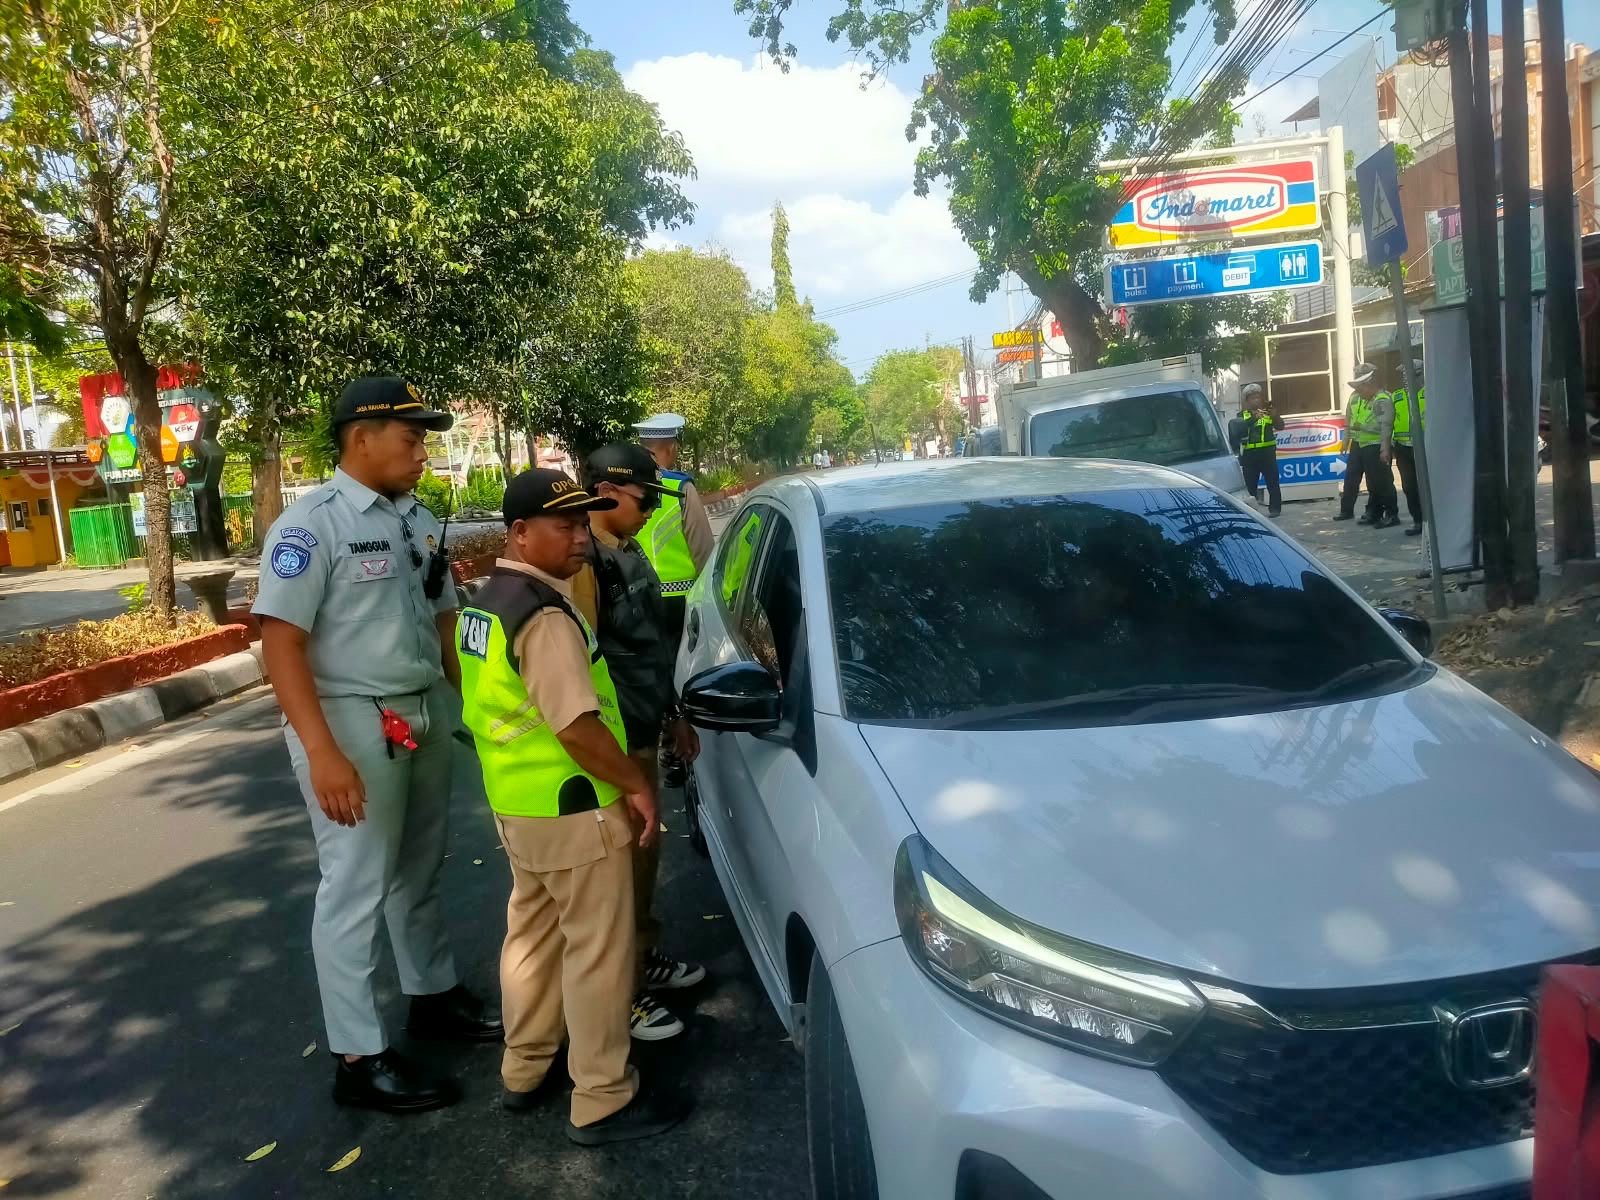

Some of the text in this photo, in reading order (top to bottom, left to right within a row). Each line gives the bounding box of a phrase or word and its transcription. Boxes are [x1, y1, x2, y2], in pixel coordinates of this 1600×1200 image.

[1146, 186, 1276, 221] Indomaret
[1225, 272, 1249, 282] DEBIT
[1167, 282, 1205, 294] payment
[1438, 275, 1465, 296] LAPT
[1124, 288, 1148, 299] pulsa
[174, 425, 193, 433] KPK
[1276, 431, 1333, 446] ndomaret
[1279, 461, 1323, 479] SUK
[348, 540, 391, 555] TANGGUH
